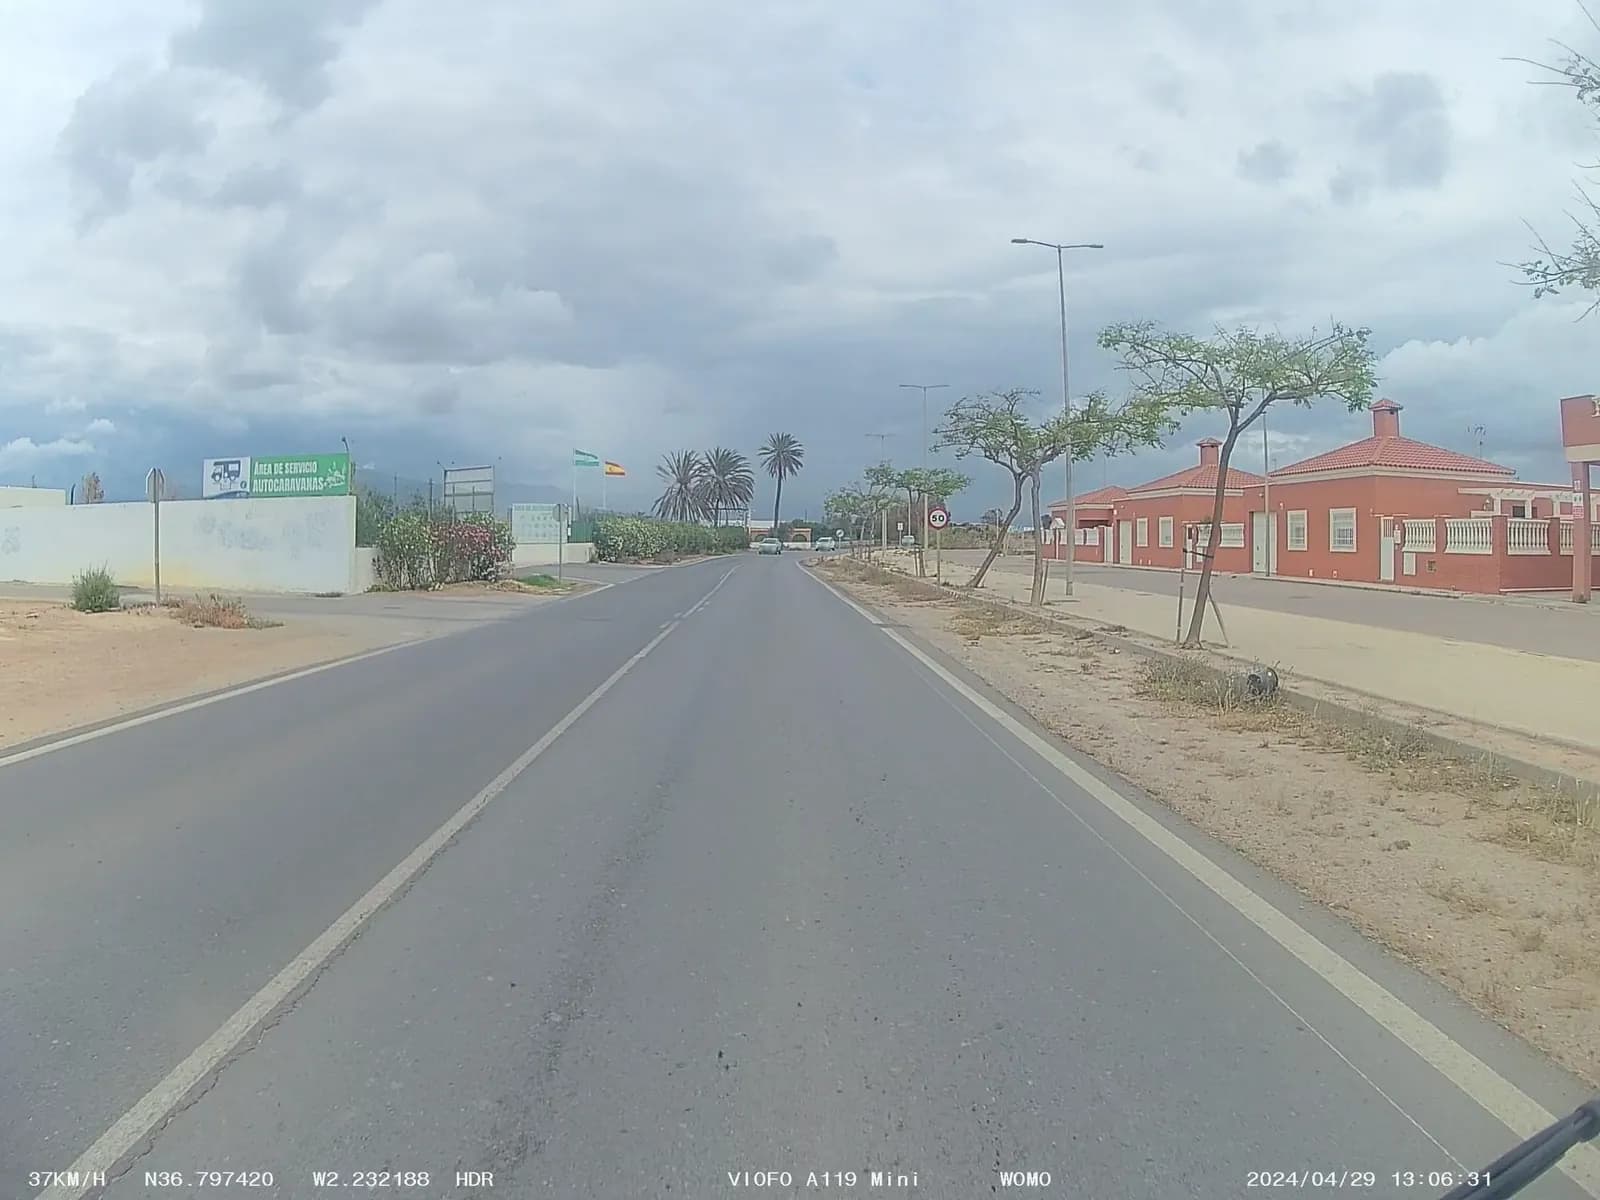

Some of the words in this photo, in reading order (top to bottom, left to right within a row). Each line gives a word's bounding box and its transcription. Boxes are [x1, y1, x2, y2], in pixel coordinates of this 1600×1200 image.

[273, 462, 283, 474] DE
[284, 461, 317, 474] SERVICIO
[252, 477, 324, 492] AUTOCARAVANAS
[931, 514, 945, 522] 50
